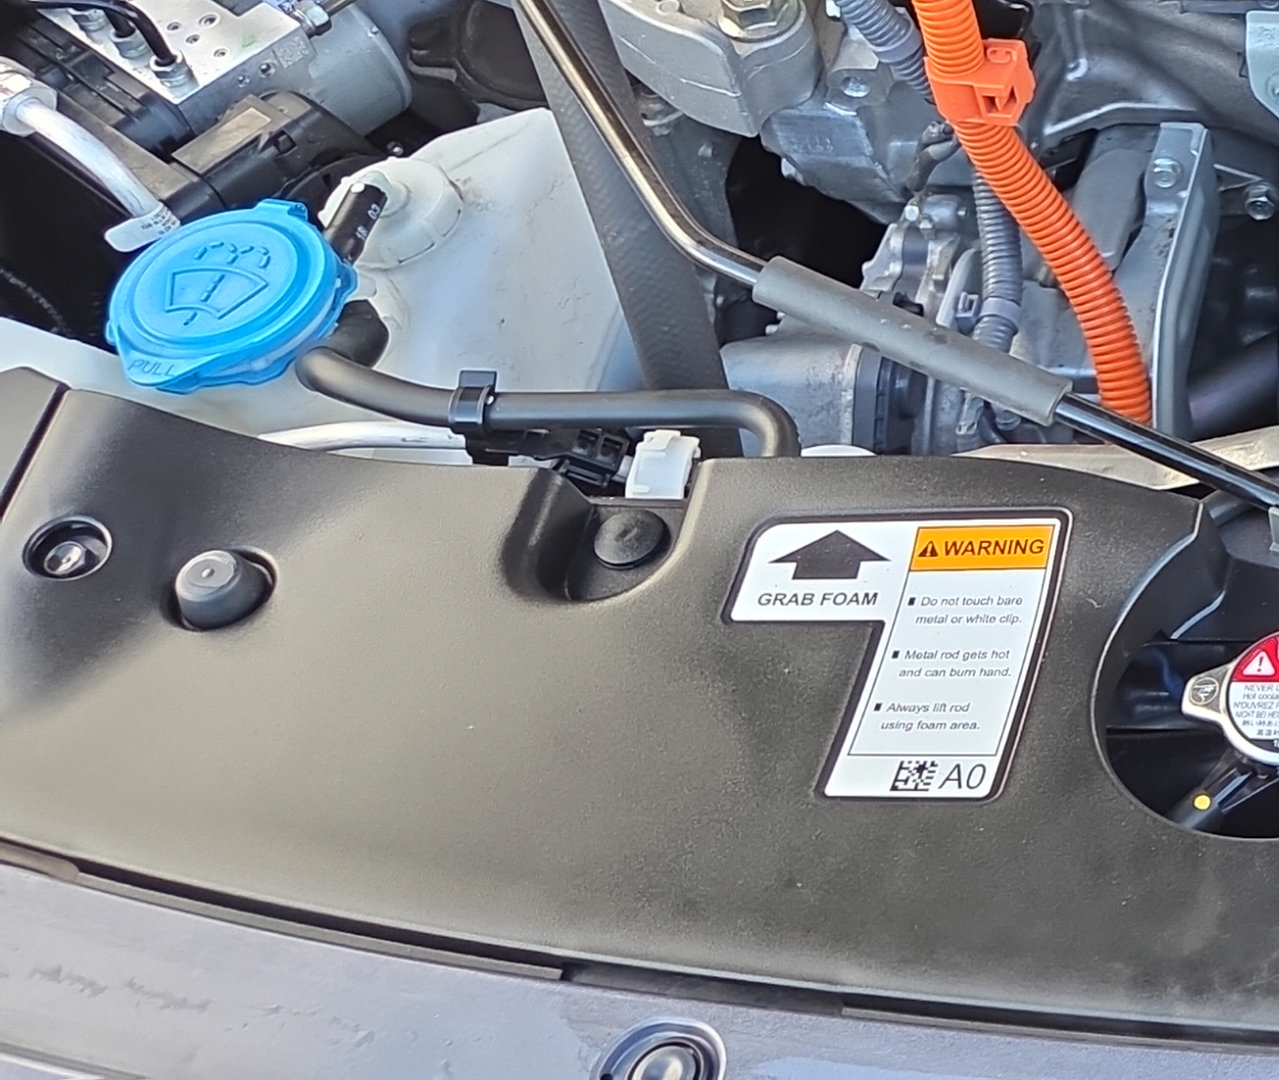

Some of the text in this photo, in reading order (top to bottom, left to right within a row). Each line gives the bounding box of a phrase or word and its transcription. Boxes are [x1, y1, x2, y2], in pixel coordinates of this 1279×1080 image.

[128, 358, 176, 378] PULL
[944, 539, 1045, 557] WARNING
[757, 592, 878, 606] GRAB FOAM
[920, 596, 1023, 606] Do not touch bare
[915, 614, 1022, 626] metal or white clip.
[904, 650, 1010, 662] Metal rod gets hot
[899, 668, 922, 678] and
[924, 669, 946, 678] can
[979, 667, 1011, 677] hand.
[886, 702, 970, 714] Always lift rod
[881, 721, 980, 732] using foam area.
[939, 764, 987, 790] A0
